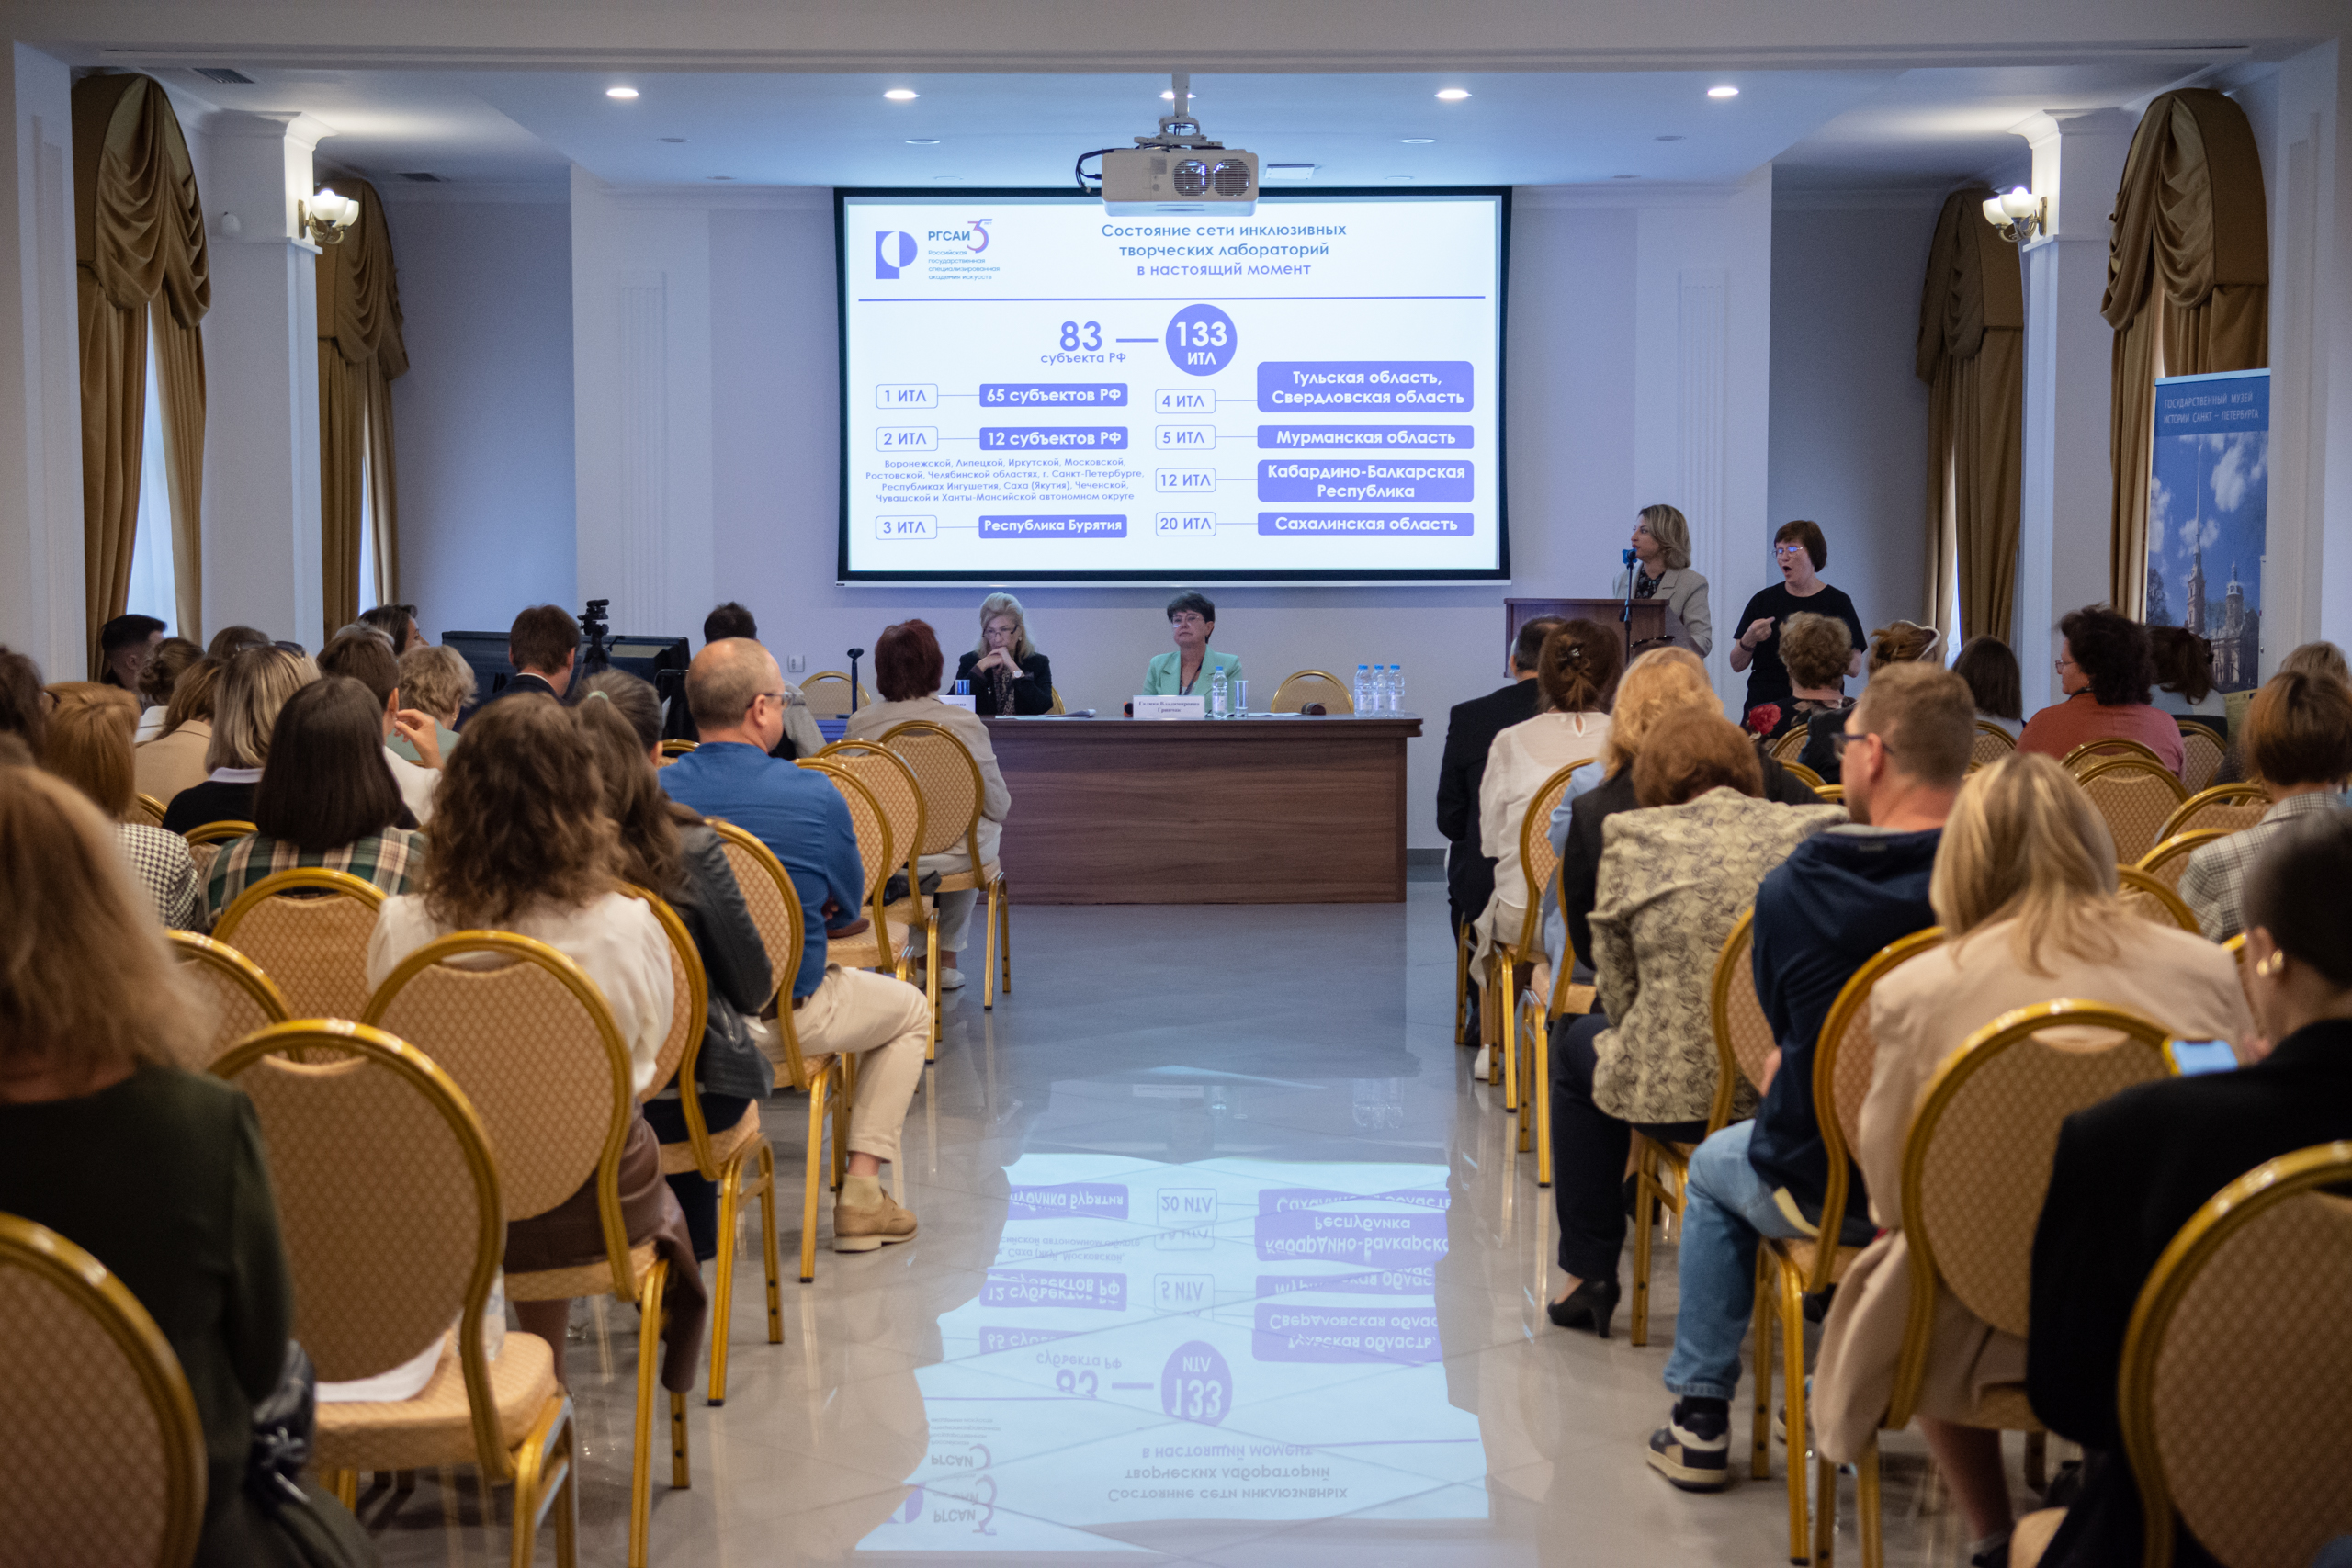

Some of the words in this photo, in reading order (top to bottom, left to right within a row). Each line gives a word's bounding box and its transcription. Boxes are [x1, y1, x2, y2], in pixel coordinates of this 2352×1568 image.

[928, 231, 971, 242] РГСАИ
[1102, 223, 1192, 238] Состояние
[1195, 226, 1235, 237] сети
[1239, 225, 1347, 236] инклюзивных
[1118, 246, 1215, 260] творческих
[1218, 242, 1329, 259] лабораторий
[1136, 265, 1146, 276] в
[1150, 262, 1243, 276] настоящий
[1247, 265, 1312, 276] момент
[1059, 321, 1103, 352] 83
[1175, 321, 1228, 347] 133
[1040, 350, 1105, 367] субъекта
[1109, 352, 1127, 365] РФ
[1187, 351, 1217, 366] ИТЛ
[1292, 370, 1365, 388] Тульская
[1368, 369, 1442, 386] область,
[885, 389, 890, 403] 1
[898, 389, 927, 402] ИТЛ
[986, 389, 1005, 402] 65
[1009, 388, 1096, 405] субъектов
[1100, 388, 1122, 401] РФ
[1161, 394, 1171, 408] 4
[1176, 395, 1205, 408] ИТЛ
[1272, 389, 1391, 407] Свердловская
[1395, 389, 1465, 404] область
[2164, 394, 2227, 409] ГОСУДАРСТВЕННЫЙ
[2231, 391, 2253, 403] МУЗЕЙ
[2164, 413, 2189, 423] ИСТОРИИ
[2192, 412, 2212, 423] САНКТ
[2222, 409, 2259, 421] ПЕТЕРБУРГА
[883, 432, 893, 446] 2
[898, 432, 927, 445] ИТЛ
[988, 431, 1006, 446] 12
[1009, 431, 1096, 448] субъектов
[1100, 431, 1122, 445] РФ
[1162, 431, 1171, 445] 5
[1176, 431, 1205, 444] ИТЛ
[1276, 430, 1383, 447] Мурманская
[1386, 430, 1456, 445] область
[884, 458, 955, 469] Воронежской,
[956, 458, 1006, 468] Липецкой,
[1008, 457, 1062, 468] Иркутской,
[1064, 457, 1126, 468] Московской,
[865, 470, 925, 480] Ростовской,
[927, 469, 990, 479] Челябинской
[992, 469, 1040, 479] областях,
[1051, 468, 1145, 479] Санкт-Петербурге,
[1160, 473, 1178, 487] 12
[1182, 473, 1212, 487] ИТЛ
[1268, 464, 1465, 481] Кабардино-Балкарская
[881, 482, 944, 492] Республиках
[946, 482, 1001, 492] Ингушетия,
[1003, 481, 1029, 490] Саха
[1031, 480, 1073, 491] (Якутия),
[1074, 480, 1129, 490] Чеченской,
[1317, 483, 1415, 501] Республика
[876, 493, 931, 504] Чувашской
[941, 493, 1037, 502] Ханты-Мансийской
[1038, 492, 1100, 502] автономном
[1102, 493, 1135, 502] округе
[883, 521, 892, 535] 3
[897, 521, 926, 534] ИТЛ
[984, 518, 1065, 534] Республика
[1069, 518, 1122, 534] Бурятия
[1159, 517, 1179, 531] 20
[1183, 517, 1212, 530] ИТЛ
[1274, 516, 1385, 531] Сахалинская
[1388, 516, 1458, 531] область
